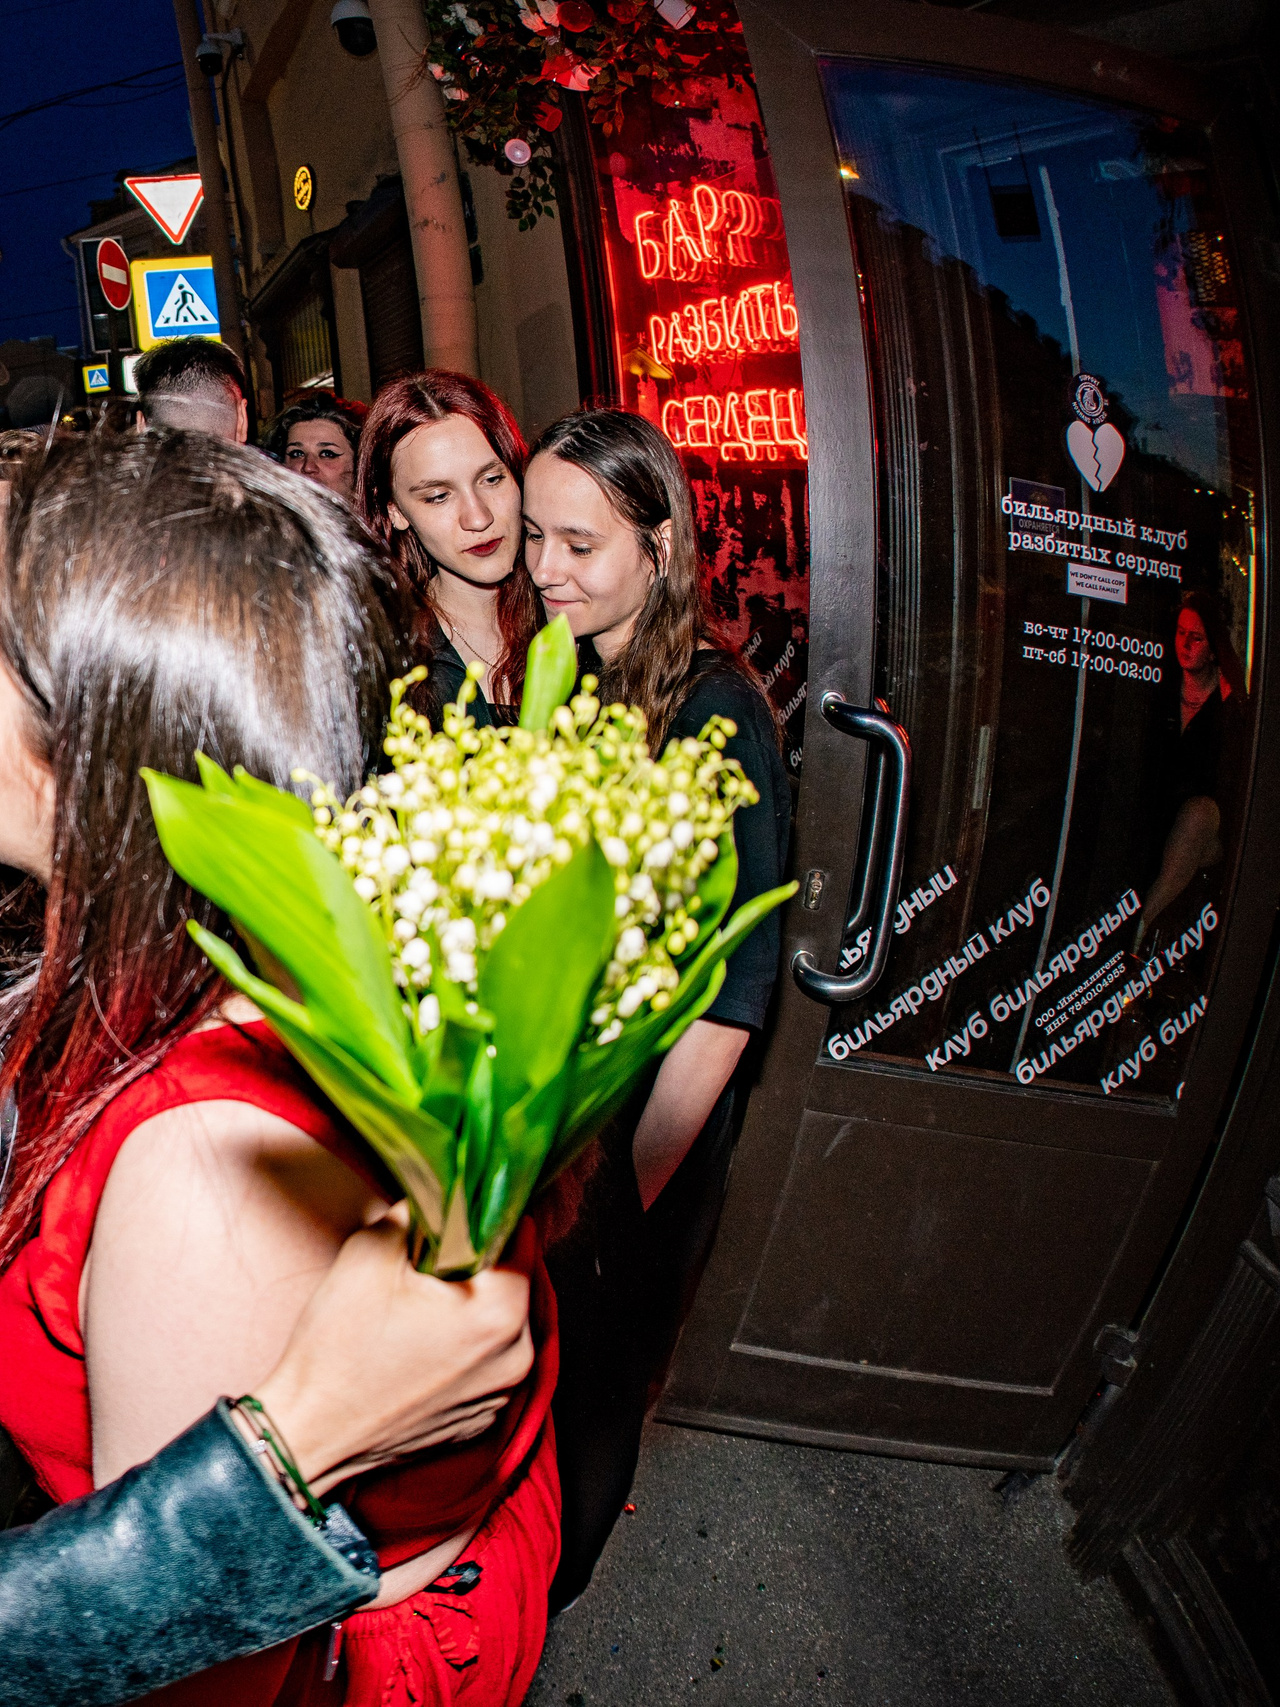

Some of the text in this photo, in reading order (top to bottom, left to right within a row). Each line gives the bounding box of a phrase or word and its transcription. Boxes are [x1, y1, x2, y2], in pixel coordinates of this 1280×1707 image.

[1001, 493, 1189, 551] бильярдный клуб
[1008, 531, 1182, 584] разбитых сердец
[1070, 570, 1125, 587] WE DON'T CALL COPS
[1075, 580, 1120, 595] WE CALL FAMILY
[775, 640, 795, 678] клуб
[1023, 621, 1164, 659] вс-чт 17:00-00:00
[1022, 645, 1163, 683] пт-сб 17:00-02:00
[827, 876, 1052, 1061] бильярдный клуб
[925, 888, 1143, 1072] клуб бильярдный
[1016, 902, 1219, 1085] бильярдный клуб
[1034, 1008, 1056, 1028] ООО
[1044, 1012, 1069, 1036] ИНН
[1100, 1035, 1157, 1095] клуб
